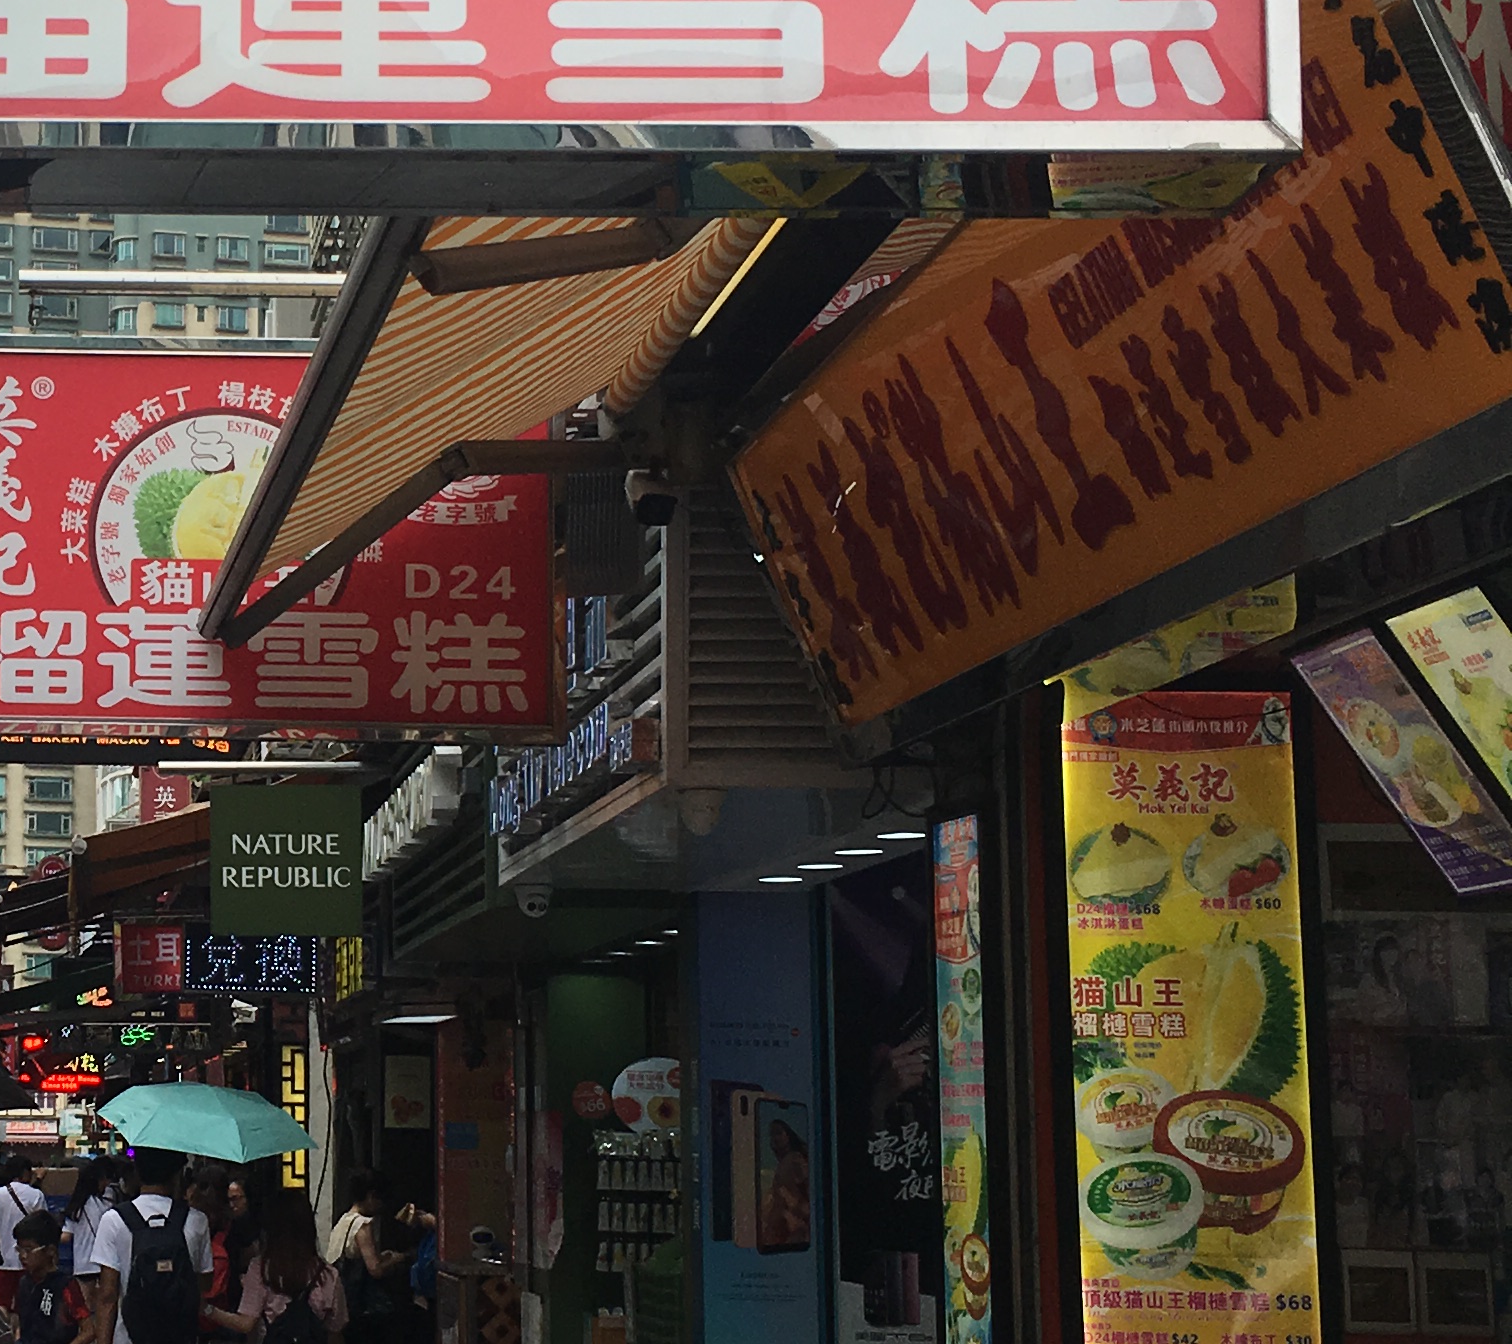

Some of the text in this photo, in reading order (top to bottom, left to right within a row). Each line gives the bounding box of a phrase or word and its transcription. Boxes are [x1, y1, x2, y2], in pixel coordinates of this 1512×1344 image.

[60, 476, 96, 564] 大菜糕
[1107, 762, 1235, 803] 莫義記
[1139, 804, 1166, 814] Mok
[1191, 804, 1209, 814] Kei
[232, 834, 340, 855] NATURE
[222, 867, 351, 887] REPUBLIC
[1255, 897, 1281, 910] $60
[1276, 1295, 1312, 1311] $68
[1172, 1333, 1198, 1344] $42
